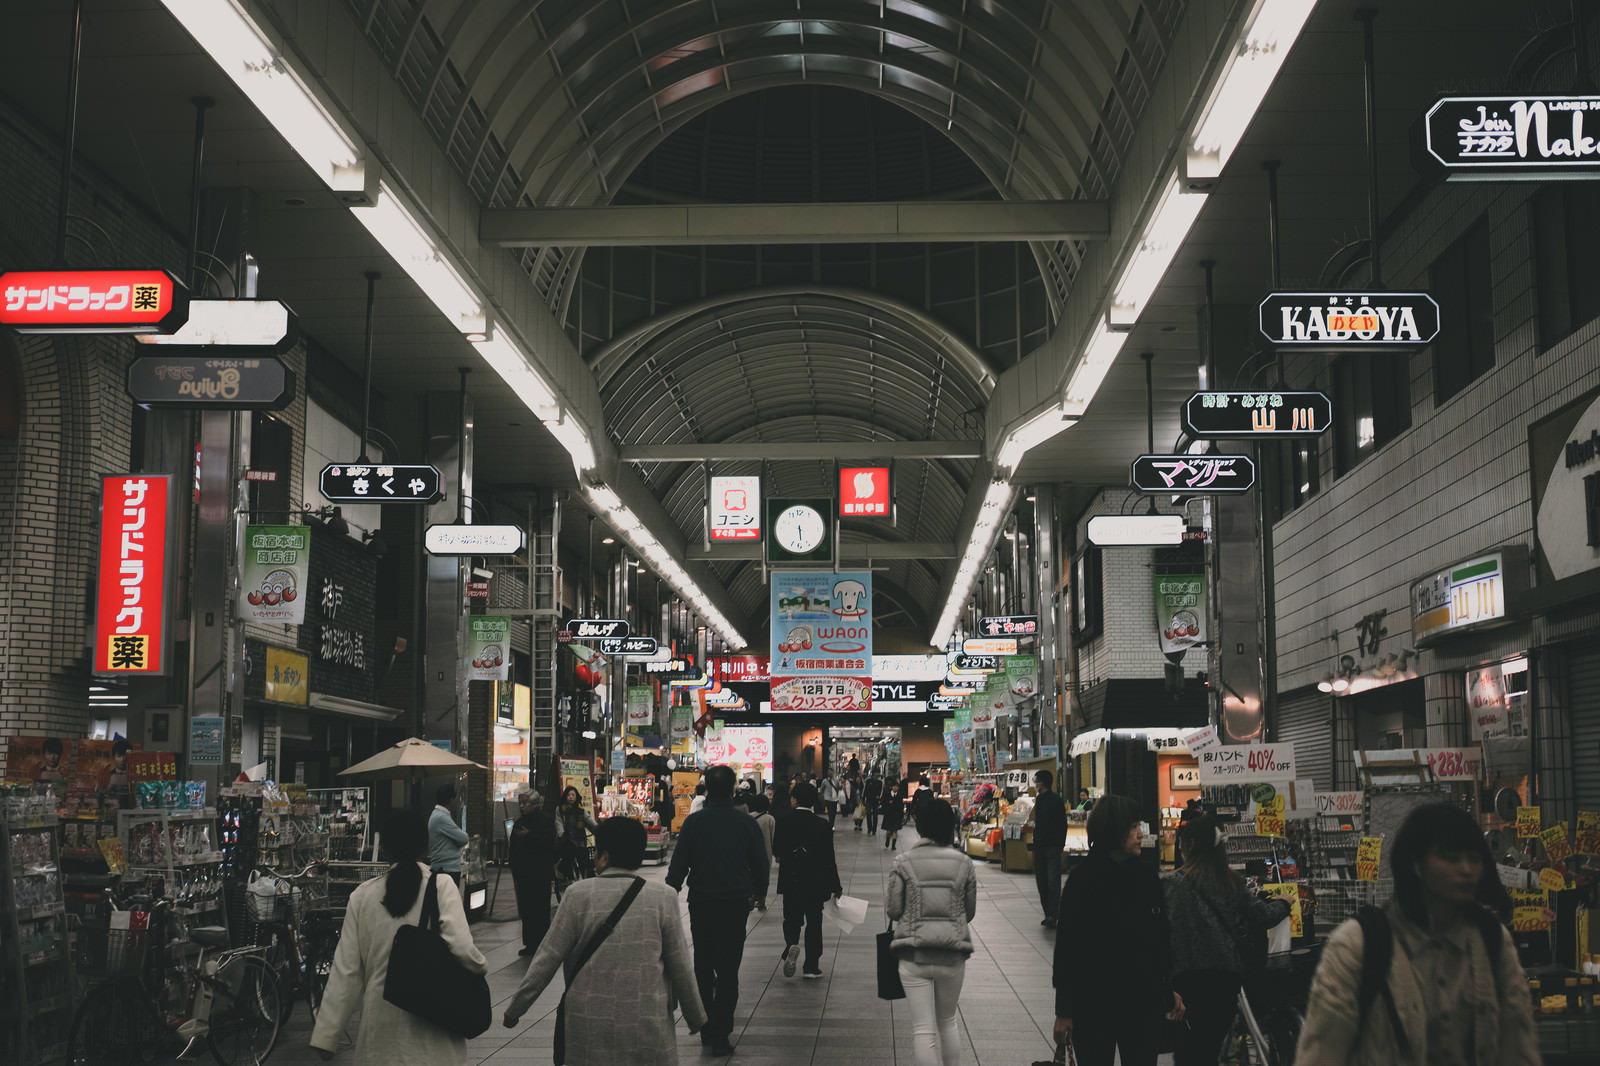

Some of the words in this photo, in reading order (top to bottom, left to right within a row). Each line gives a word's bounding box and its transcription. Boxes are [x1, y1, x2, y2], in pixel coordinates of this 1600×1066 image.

[1459, 106, 1512, 132] Join
[1510, 101, 1600, 158] Nak
[1459, 136, 1514, 152] ナカタ
[5, 285, 130, 311] サンドラッグ
[134, 286, 158, 310] 薬
[1281, 306, 1421, 340] KADOYA
[1203, 395, 1283, 408] 時計・めがね
[1152, 460, 1237, 488] マンリー
[352, 477, 426, 496] きくや
[717, 515, 755, 526] コニシ
[115, 479, 149, 634] サンドラッグ
[817, 627, 868, 639] WAON
[112, 636, 144, 669] 薬
[872, 685, 917, 699] STYLE
[1247, 749, 1276, 772] 40%
[1276, 762, 1291, 771] OFF
